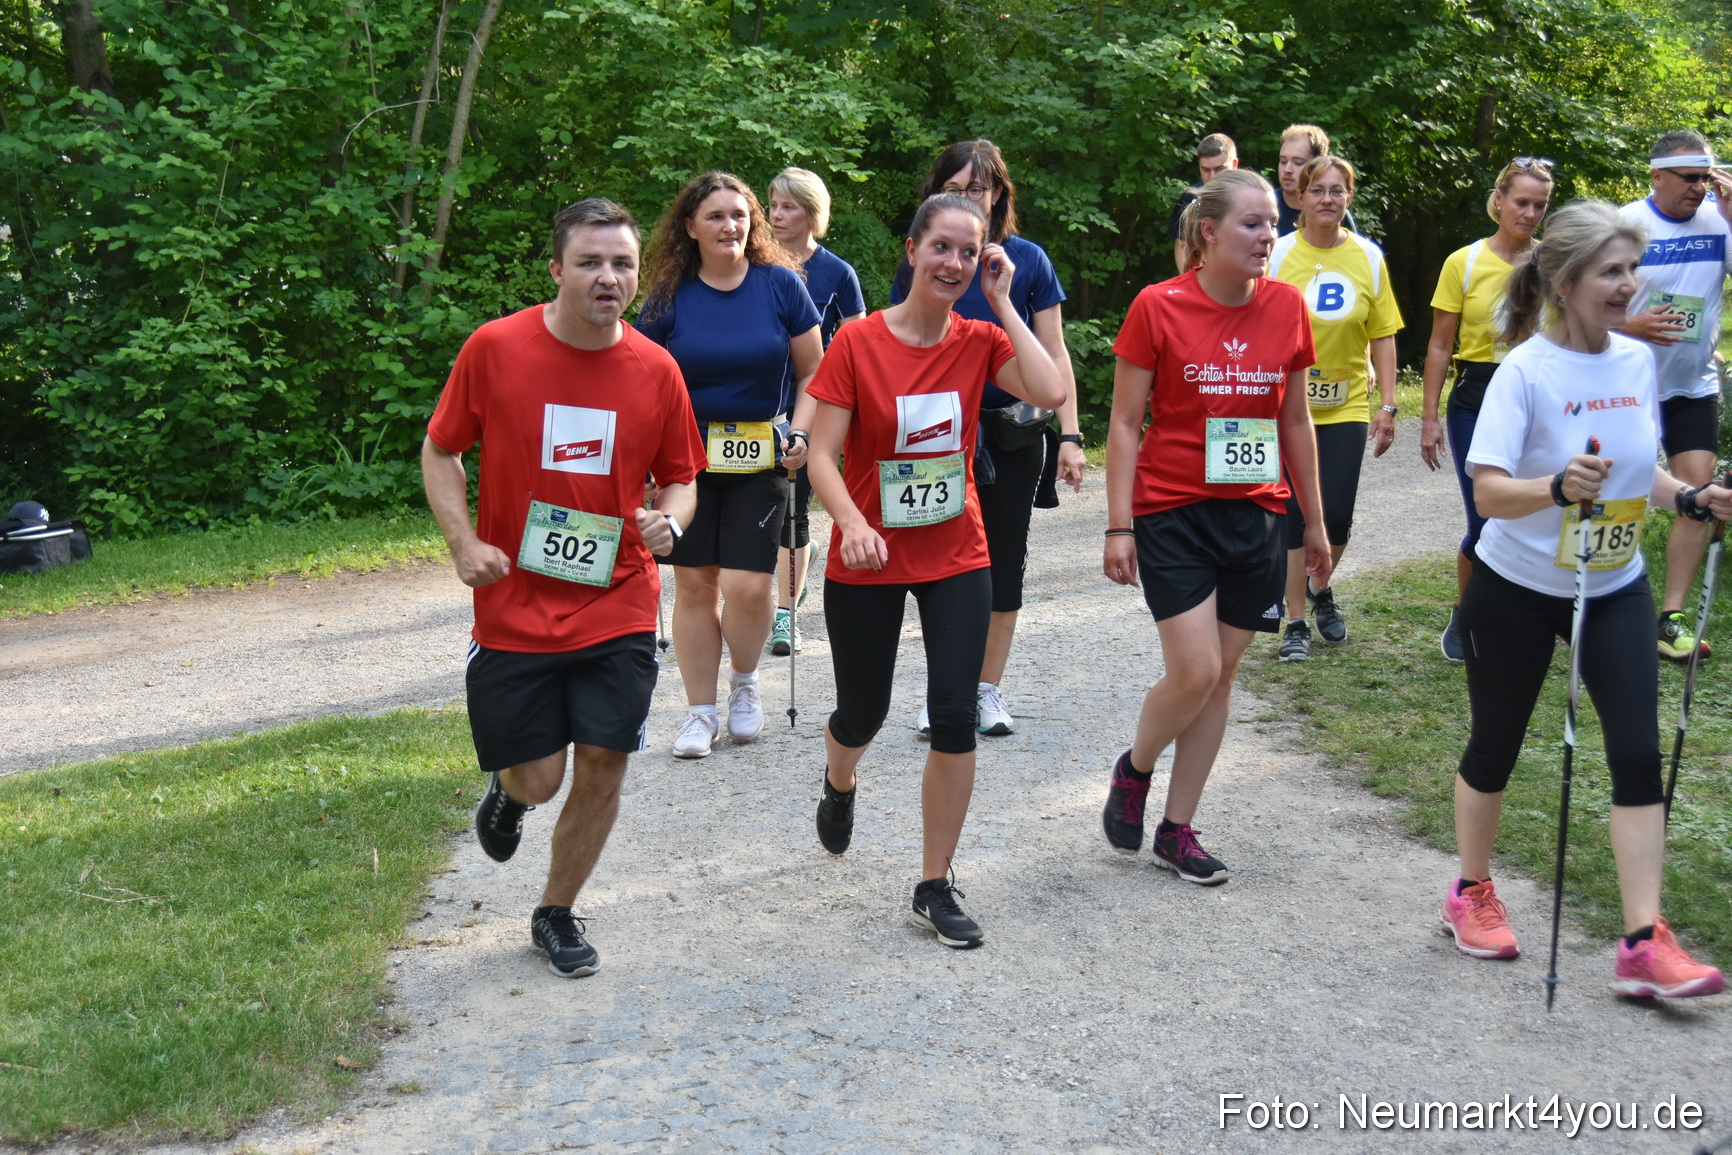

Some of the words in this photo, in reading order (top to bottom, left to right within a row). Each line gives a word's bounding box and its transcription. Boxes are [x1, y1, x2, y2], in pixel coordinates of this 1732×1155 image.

[1665, 239, 1713, 253] PLAST
[1316, 282, 1345, 312] B
[1183, 363, 1225, 383] Echtes
[1225, 364, 1284, 384] Handwerk
[1198, 385, 1232, 395] IMMER
[1236, 386, 1271, 396] FRISCH
[1307, 382, 1339, 399] 351
[1586, 397, 1641, 411] KLEBL
[566, 446, 588, 456] DEHN
[722, 440, 761, 459] 809
[1224, 442, 1266, 466] 585
[899, 481, 949, 508] 473
[906, 508, 930, 517] Carlisi
[930, 505, 946, 513] Julia
[1573, 522, 1636, 552] 185
[543, 531, 598, 565] 502
[543, 556, 561, 567] Iberl
[562, 561, 591, 572] Raphael
